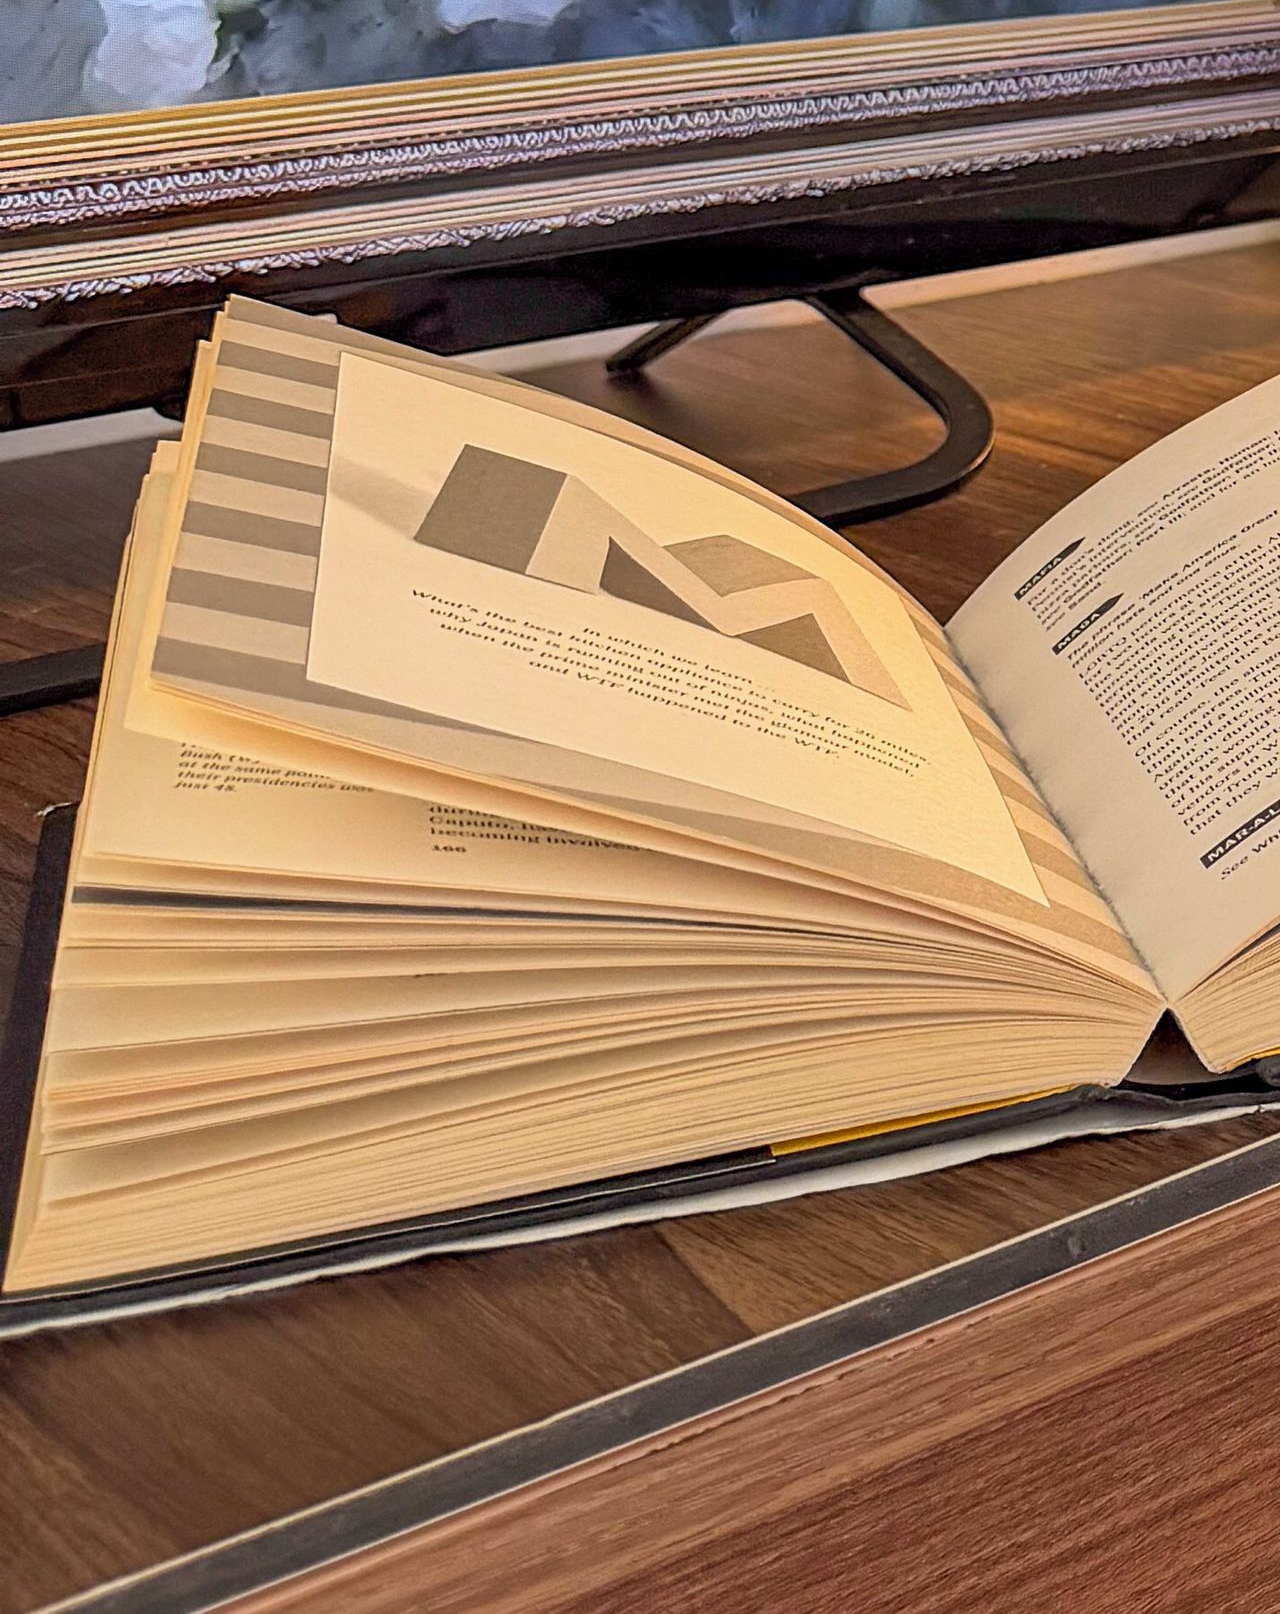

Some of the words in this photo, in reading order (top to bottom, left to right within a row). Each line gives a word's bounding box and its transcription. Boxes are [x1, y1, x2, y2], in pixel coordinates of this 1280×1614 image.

[1019, 556, 1062, 596] MAFIA
[1067, 640, 1088, 660] The
[1091, 603, 1135, 640] phrase
[1182, 534, 1237, 572] America
[1240, 509, 1277, 533] Great
[1058, 613, 1100, 650] MAGA
[1071, 631, 1114, 668] million
[1116, 606, 1145, 630] hats
[1148, 584, 1172, 605] and
[1176, 567, 1200, 585] one
[1134, 741, 1151, 757] Of
[1213, 678, 1239, 696] the
[1140, 738, 1174, 765] than
[1178, 720, 1197, 735] on
[1248, 663, 1280, 682] The
[1146, 745, 1181, 773] than
[1183, 719, 1213, 744] half
[1217, 712, 1226, 720] a
[1222, 705, 1275, 741] during
[1164, 773, 1196, 799] that
[1198, 756, 1219, 772] he
[1222, 719, 1269, 754] would
[1177, 768, 1240, 815] vendors
[1243, 754, 1259, 766] in
[1171, 793, 1185, 808] of
[1188, 774, 1213, 793] his
[1183, 796, 1221, 826] from
[1189, 809, 1221, 835] that
[1225, 780, 1260, 807] they
[1220, 855, 1248, 880] See
